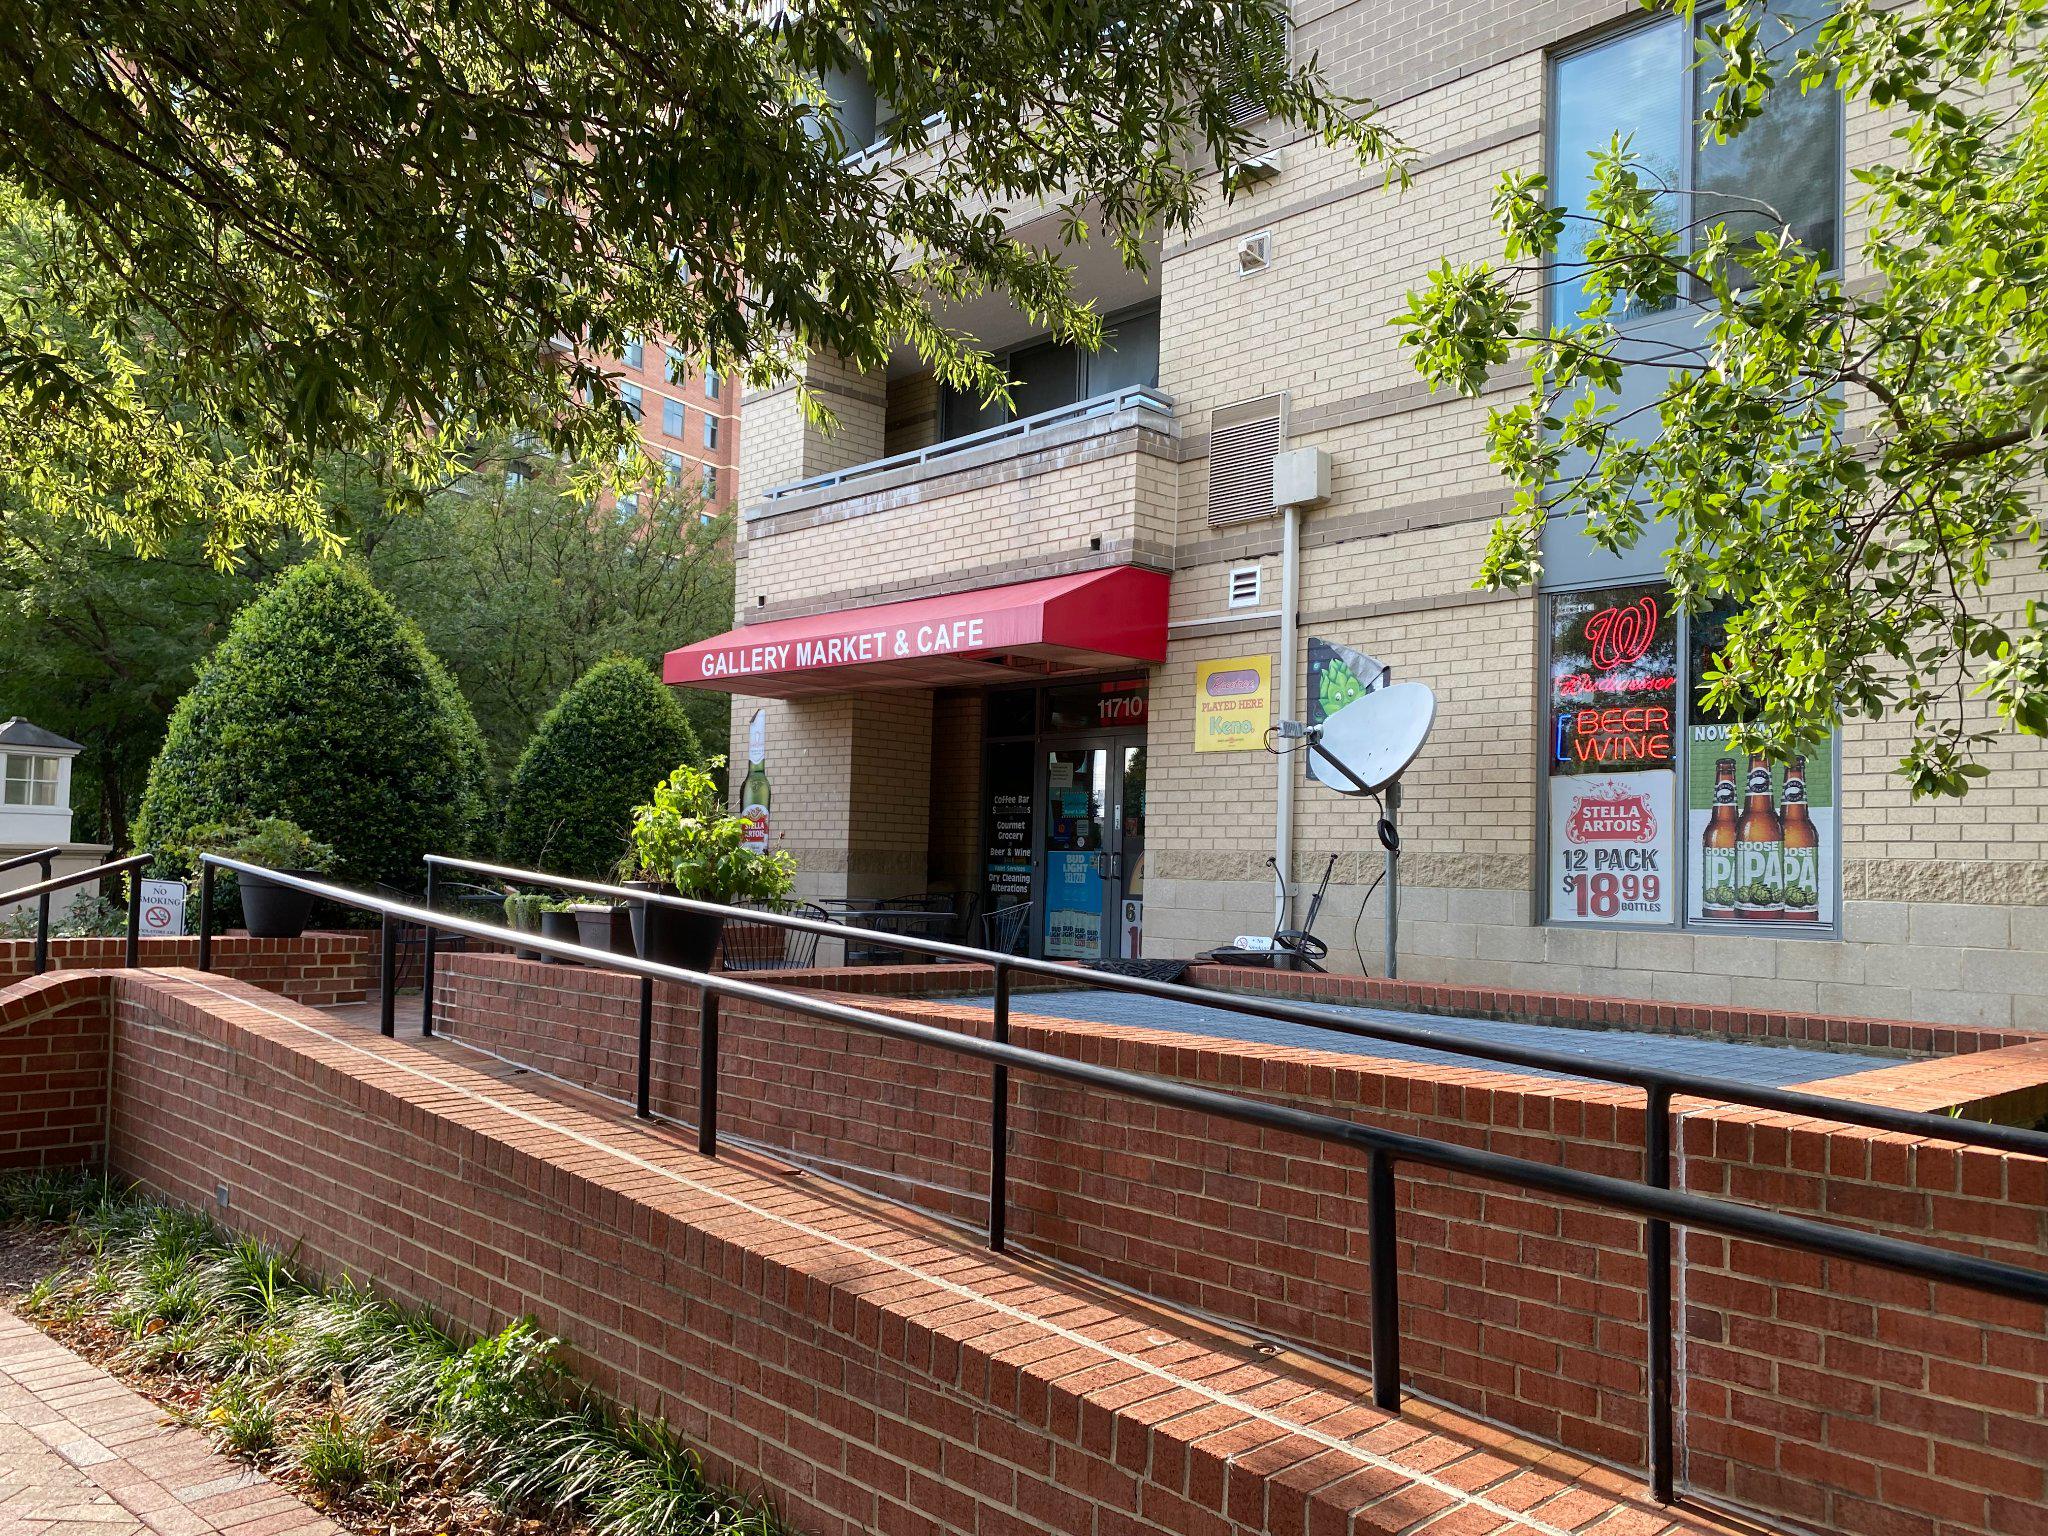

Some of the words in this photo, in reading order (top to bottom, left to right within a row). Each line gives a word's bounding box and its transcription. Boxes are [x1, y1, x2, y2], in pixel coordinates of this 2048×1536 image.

[701, 644, 791, 677] GALLERY
[796, 631, 887, 667] MARKET
[893, 629, 910, 656] &
[917, 618, 984, 653] CAFE
[1097, 696, 1143, 719] 11710
[1201, 700, 1237, 713] PLAYED
[1238, 698, 1264, 710] HERE
[1209, 715, 1253, 736] Keno
[1577, 707, 1669, 734] BEER
[1574, 734, 1670, 761] WINE
[994, 795, 1017, 804] Coffee
[1018, 795, 1030, 804] Bar
[1582, 805, 1641, 818] STELLA
[996, 821, 1026, 830] Gourmet
[1582, 819, 1641, 832] ARTOIS
[997, 831, 1024, 841] Grocery
[989, 847, 1006, 856] Beer
[1014, 847, 1031, 857] Wine
[1736, 840, 1779, 852] GOOSE
[1066, 854, 1086, 864] BUD
[1562, 849, 1588, 872] 12
[1594, 848, 1659, 872] PACK
[1063, 863, 1088, 873] LIGHT
[1737, 850, 1784, 891] IPA
[988, 873, 1001, 882] Dry
[1002, 873, 1031, 884] Cleaning
[153, 887, 167, 895] NO
[990, 883, 1028, 893] Alterations
[1621, 902, 1661, 912] BOTTLES
